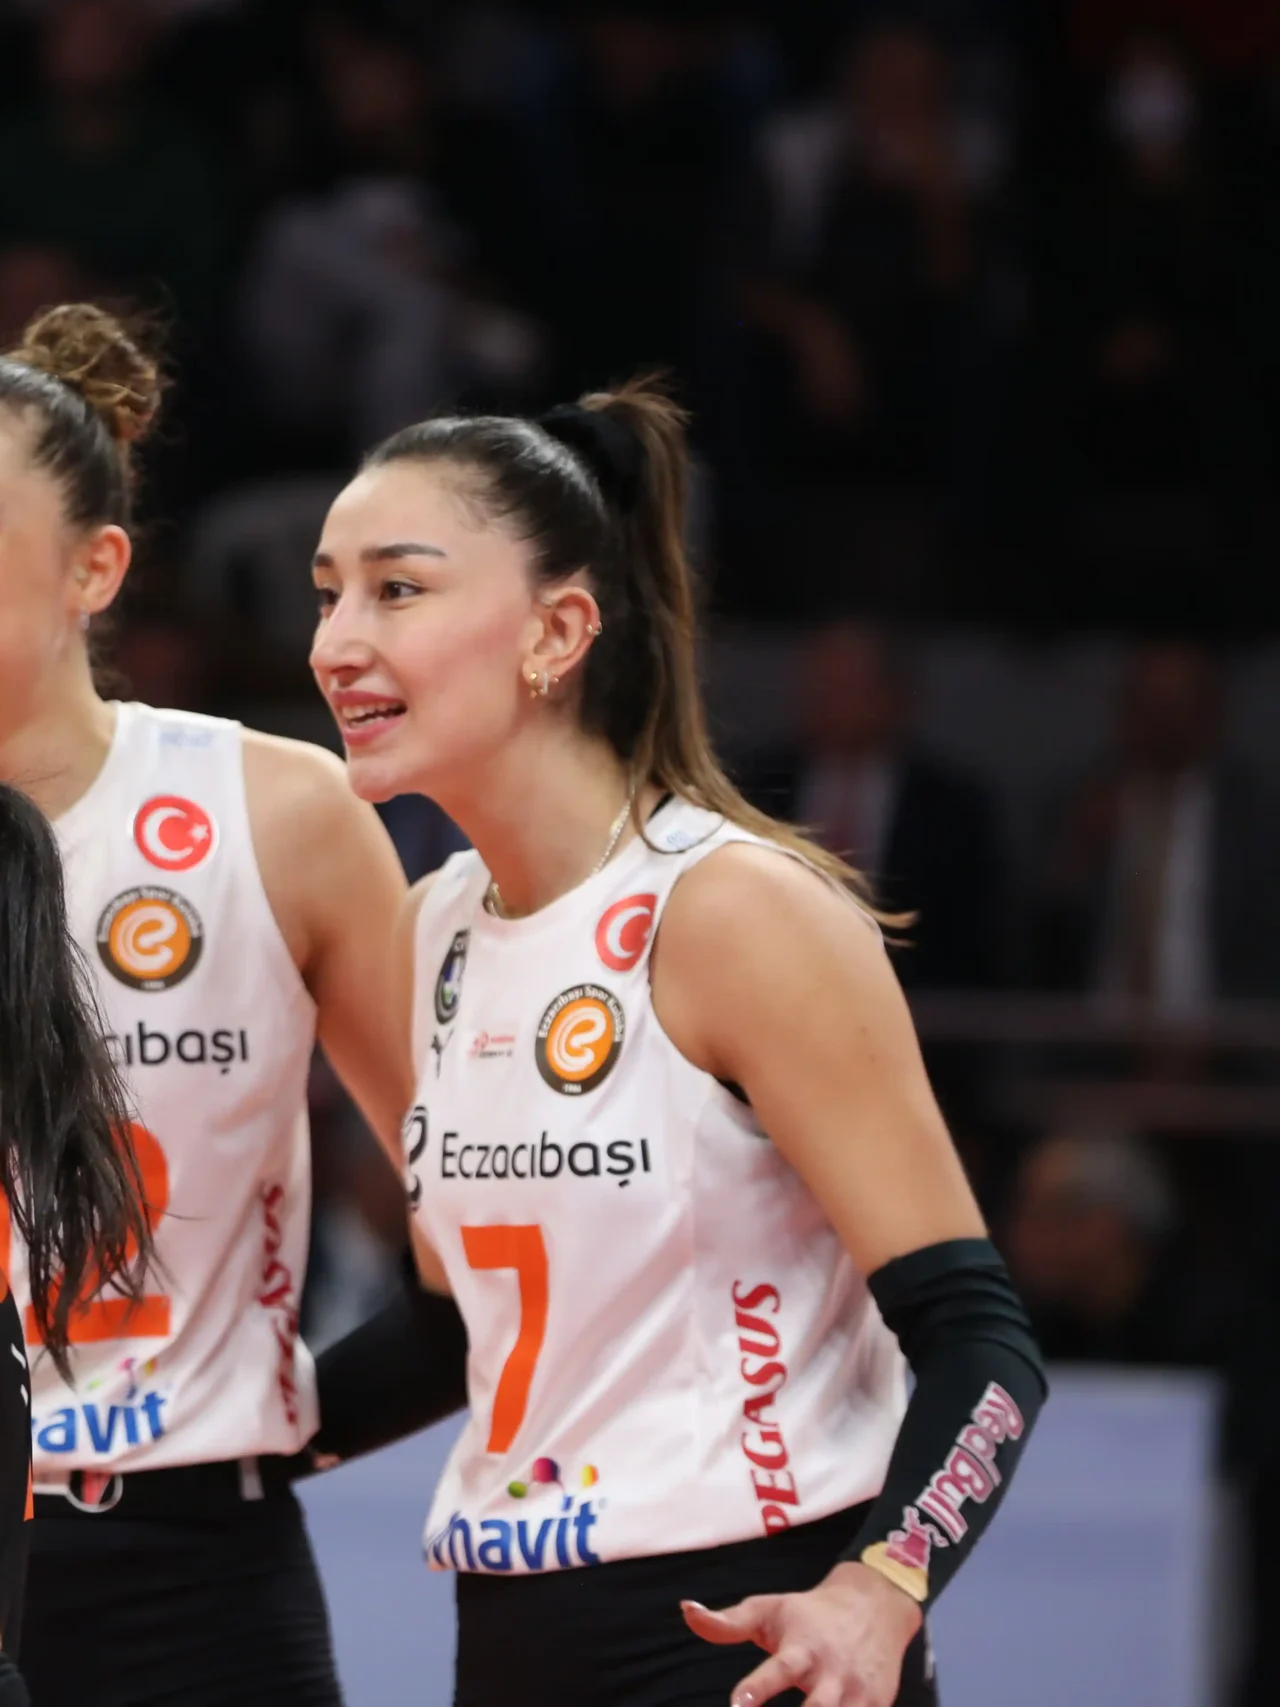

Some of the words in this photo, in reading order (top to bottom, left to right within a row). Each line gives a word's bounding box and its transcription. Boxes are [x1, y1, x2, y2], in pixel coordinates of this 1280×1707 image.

[441, 1130, 652, 1188] Eczacıbaşı
[460, 1223, 550, 1455] 7
[31, 1384, 167, 1454] avit
[731, 1279, 801, 1537] PEGASUS
[432, 1495, 600, 1572] navit
